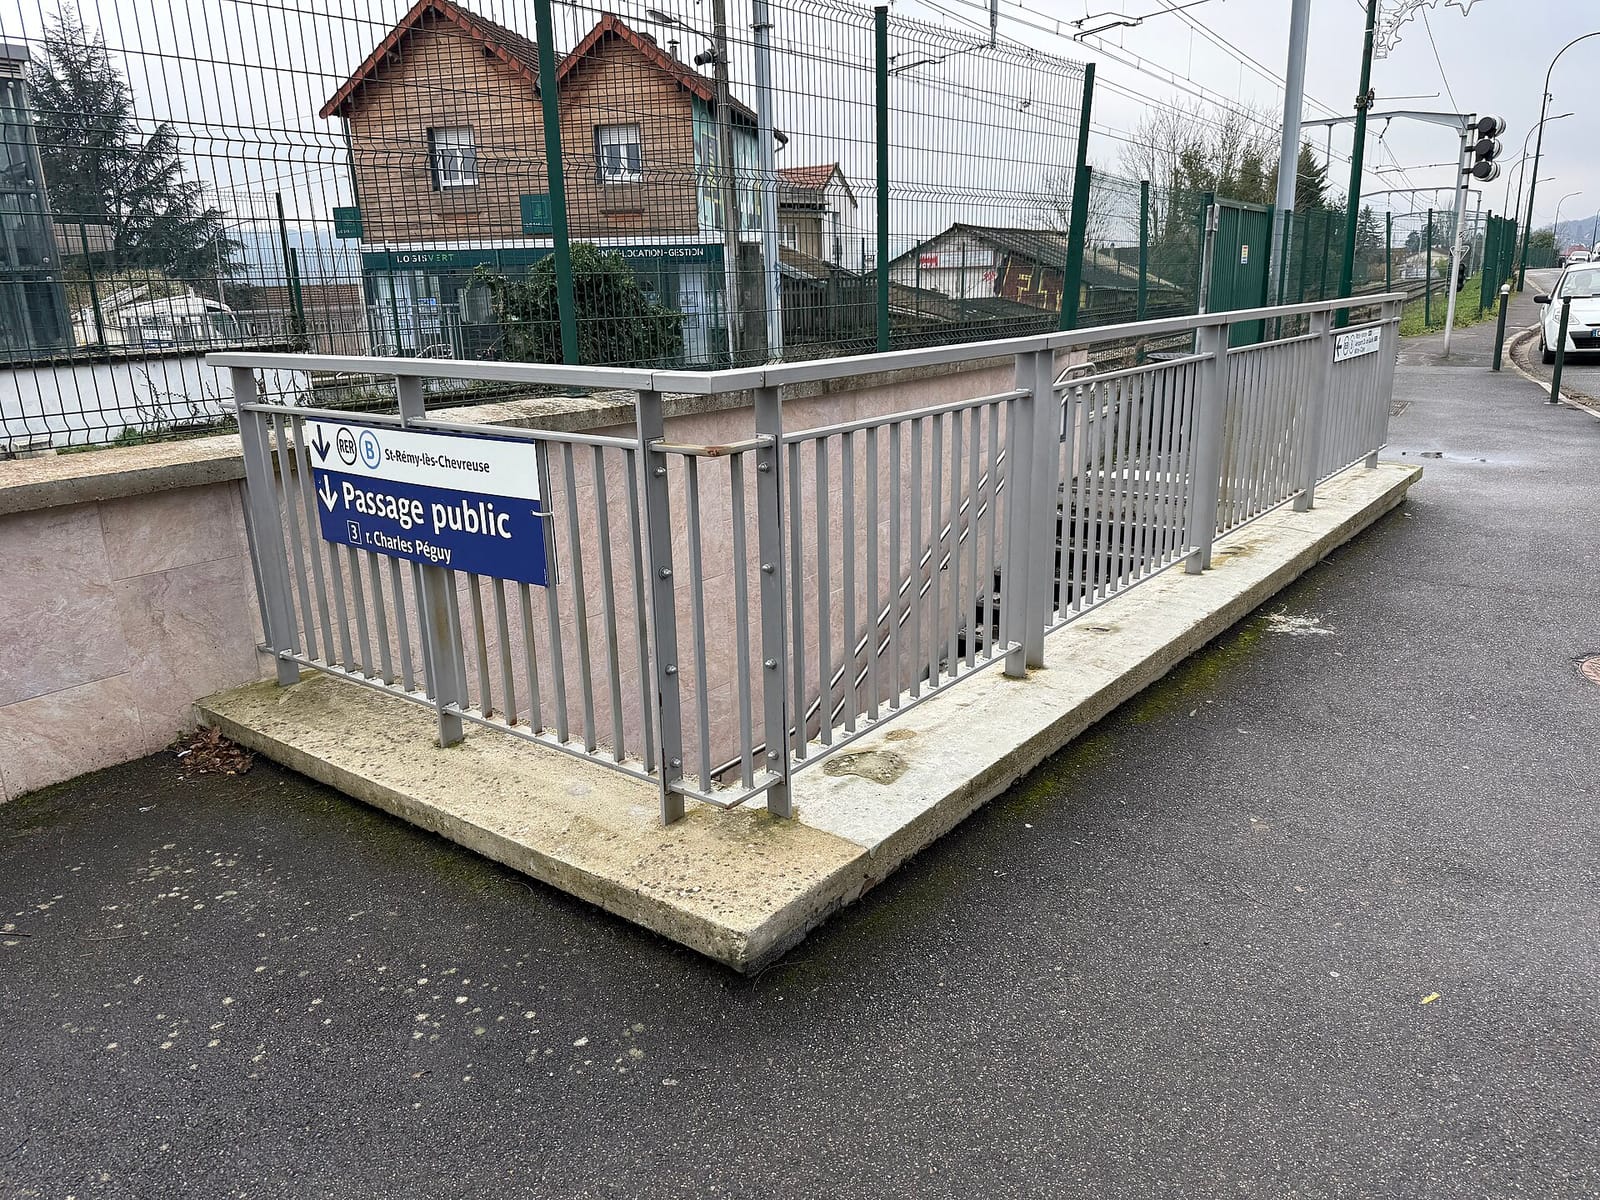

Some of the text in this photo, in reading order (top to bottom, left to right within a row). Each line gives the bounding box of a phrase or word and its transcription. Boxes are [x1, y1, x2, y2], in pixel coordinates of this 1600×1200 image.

[338, 438, 490, 473] RER B St-Rémy-lès-Chevreuse
[341, 481, 512, 539] Passage public
[350, 524, 452, 564] 3 r. Charles Péguy
